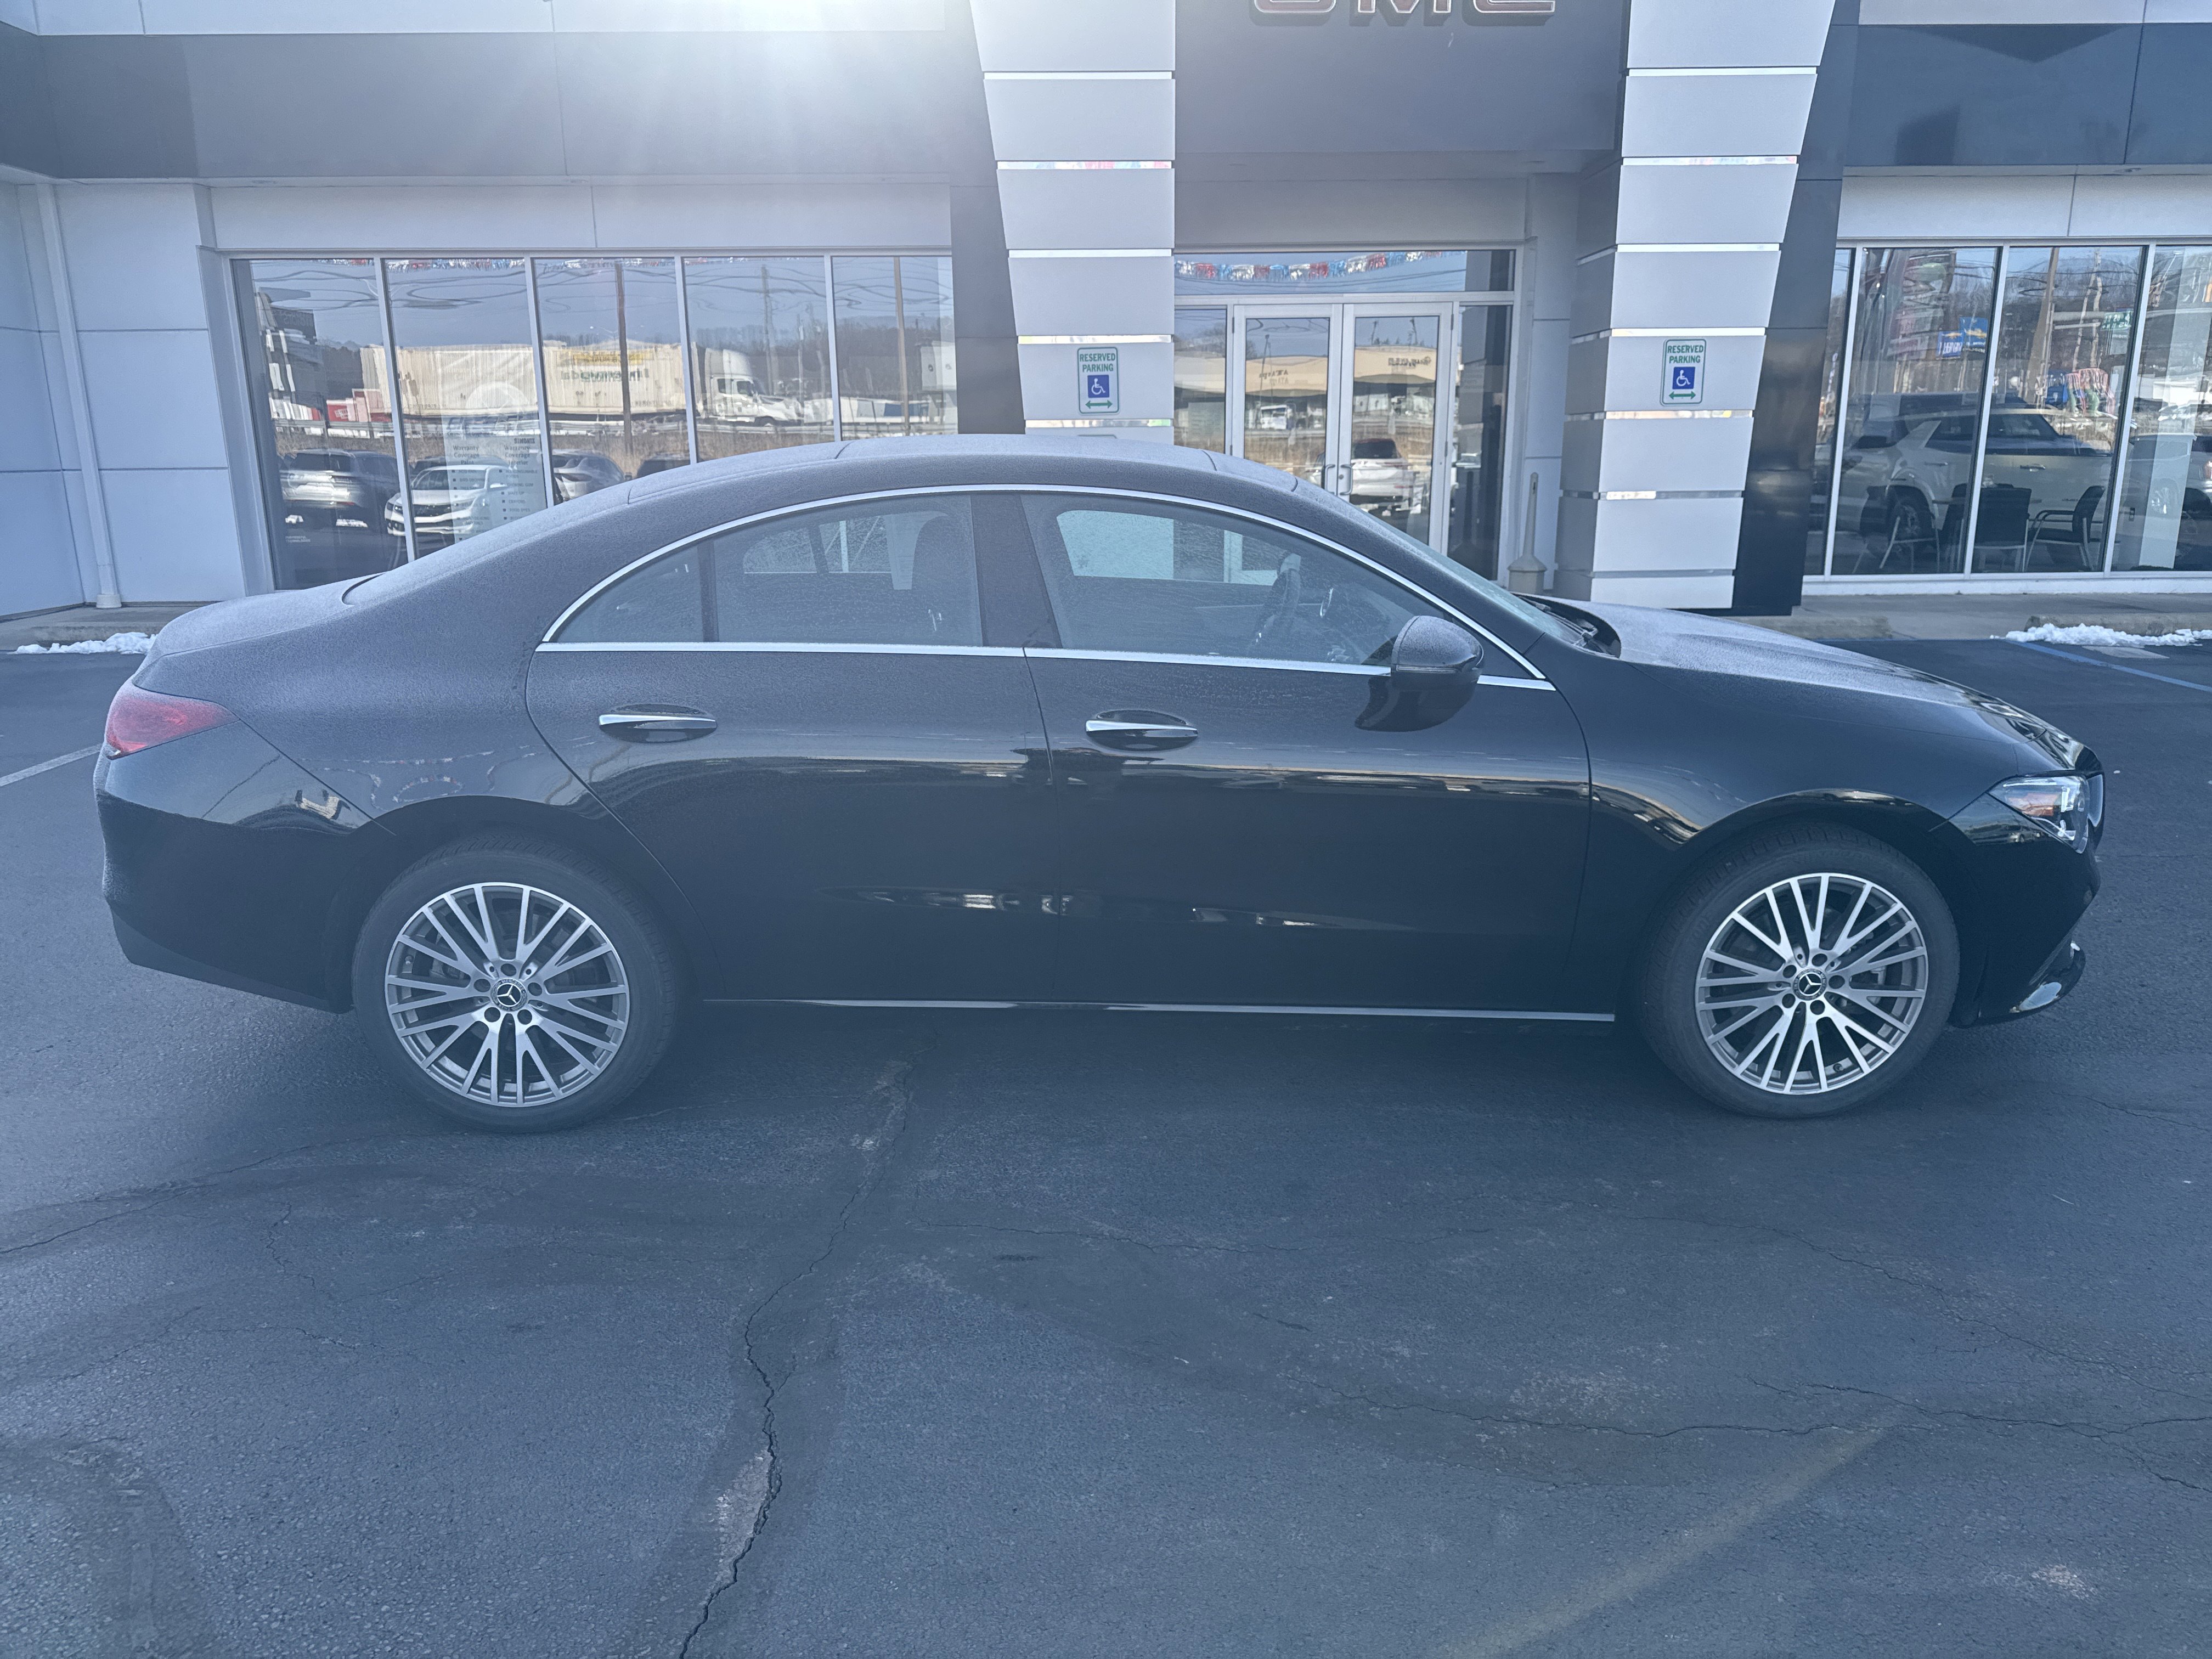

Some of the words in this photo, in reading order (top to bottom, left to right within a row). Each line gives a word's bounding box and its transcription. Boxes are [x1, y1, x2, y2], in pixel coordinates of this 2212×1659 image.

[1667, 345, 1704, 353] RESERVED
[1079, 353, 1116, 362] RESERVED
[1669, 355, 1701, 363] PARKING
[1082, 363, 1114, 373] PARKING
